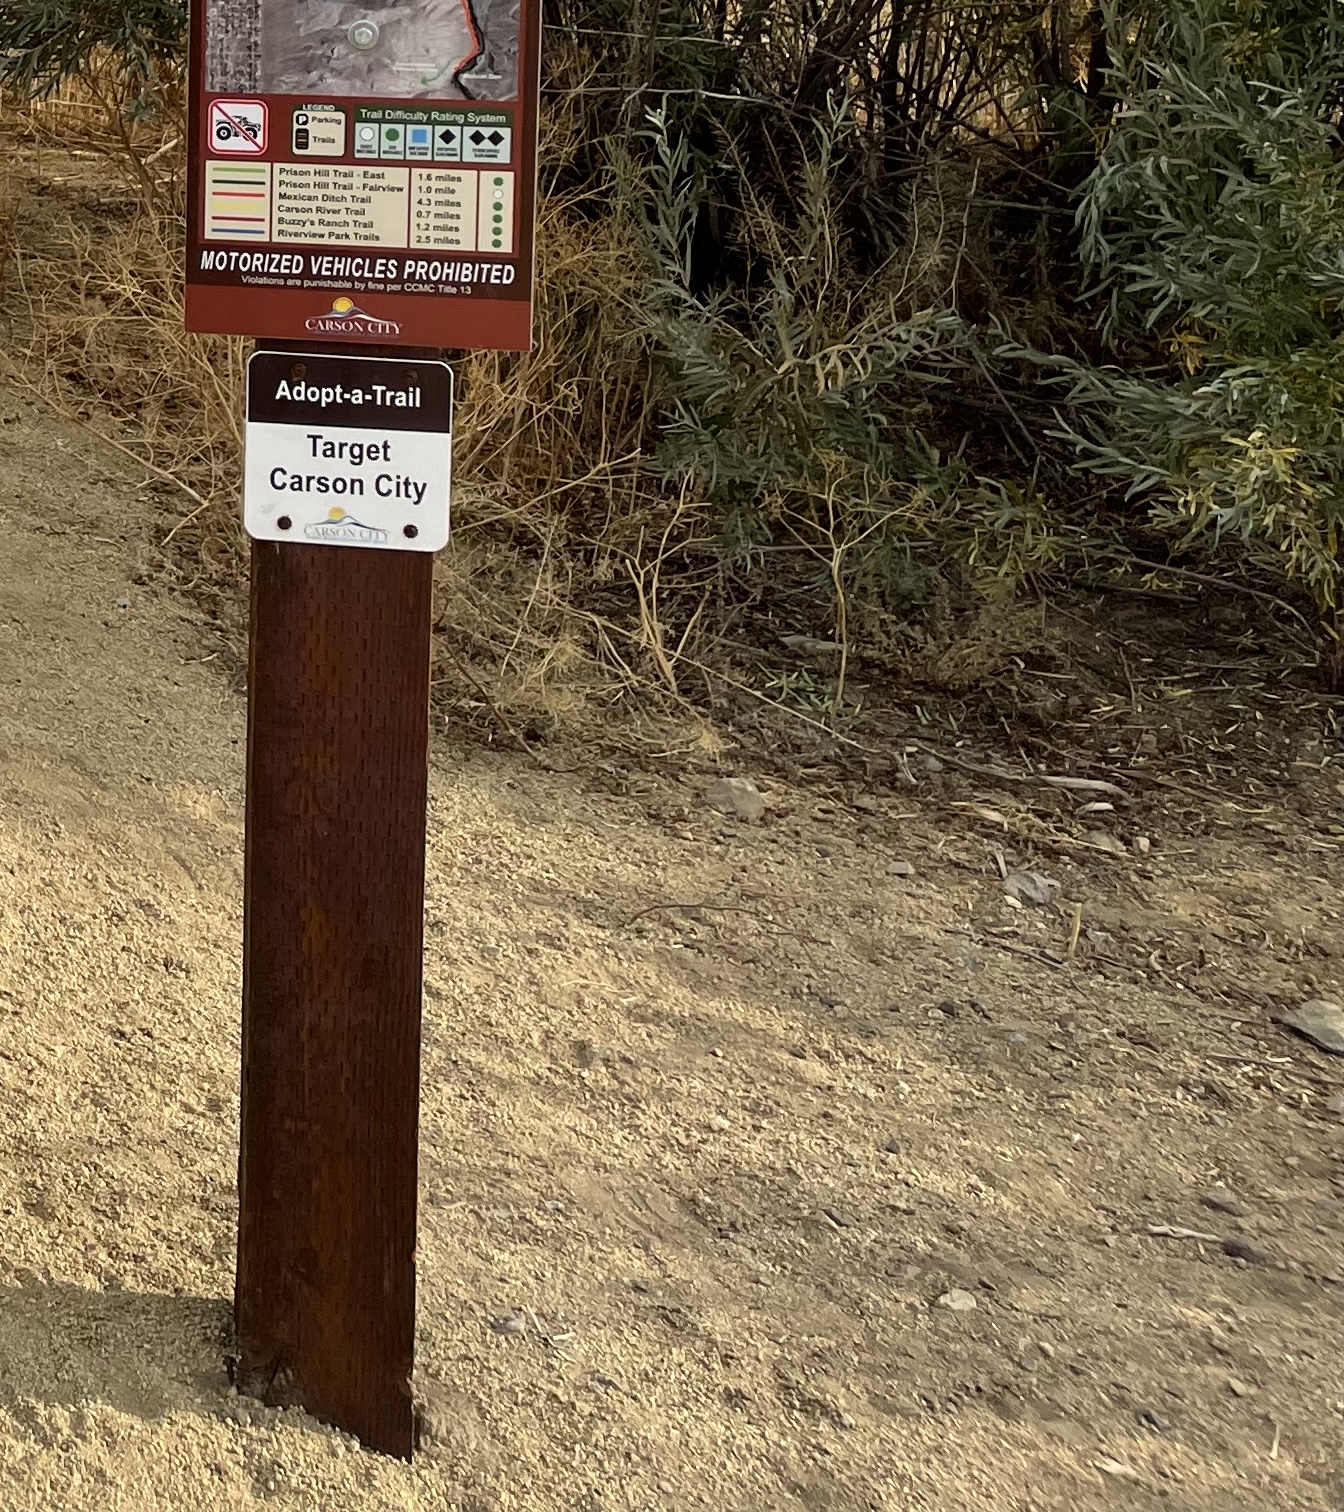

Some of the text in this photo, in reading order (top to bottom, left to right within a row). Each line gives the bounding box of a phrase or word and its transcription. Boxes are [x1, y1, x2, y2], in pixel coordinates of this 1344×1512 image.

[312, 116, 341, 125] Parking
[361, 109, 506, 124] Trail Difficulty Rating System
[279, 167, 310, 177] Prison
[313, 169, 330, 177] Hill
[333, 170, 354, 178] Trail
[363, 171, 385, 180] East
[418, 173, 462, 183] 1.6 miles
[279, 180, 310, 189] Prison
[313, 181, 330, 190] Hill
[333, 182, 353, 191] Trail
[362, 183, 404, 193] Fairview
[418, 186, 456, 195] 1.0 mile
[279, 192, 372, 204] Mexican Ditch Trail
[417, 198, 461, 208] 4.3 miles
[278, 205, 366, 216] Carson River Trail
[417, 211, 461, 220] 0.7 miles
[318, 219, 349, 228] Ranch
[352, 220, 374, 228] Trail
[417, 223, 459, 232] 1.2 miles
[278, 230, 380, 241] Riverview Park Trails
[416, 236, 460, 245] 2.5 miles
[201, 251, 515, 285] MOTORIZED VEHICLES PROHIBITED
[242, 275, 285, 286] Violations
[287, 278, 301, 286] are
[303, 278, 352, 290] punishable
[354, 279, 366, 290] by
[386, 283, 401, 293] per
[461, 286, 472, 295] 13
[305, 318, 403, 334] CARSON CITY
[275, 380, 420, 407] Adopt-a-Trail
[307, 434, 391, 466] Target
[270, 467, 427, 505] Carson City
[304, 524, 355, 538] CARSON
[360, 529, 391, 540] CITY
